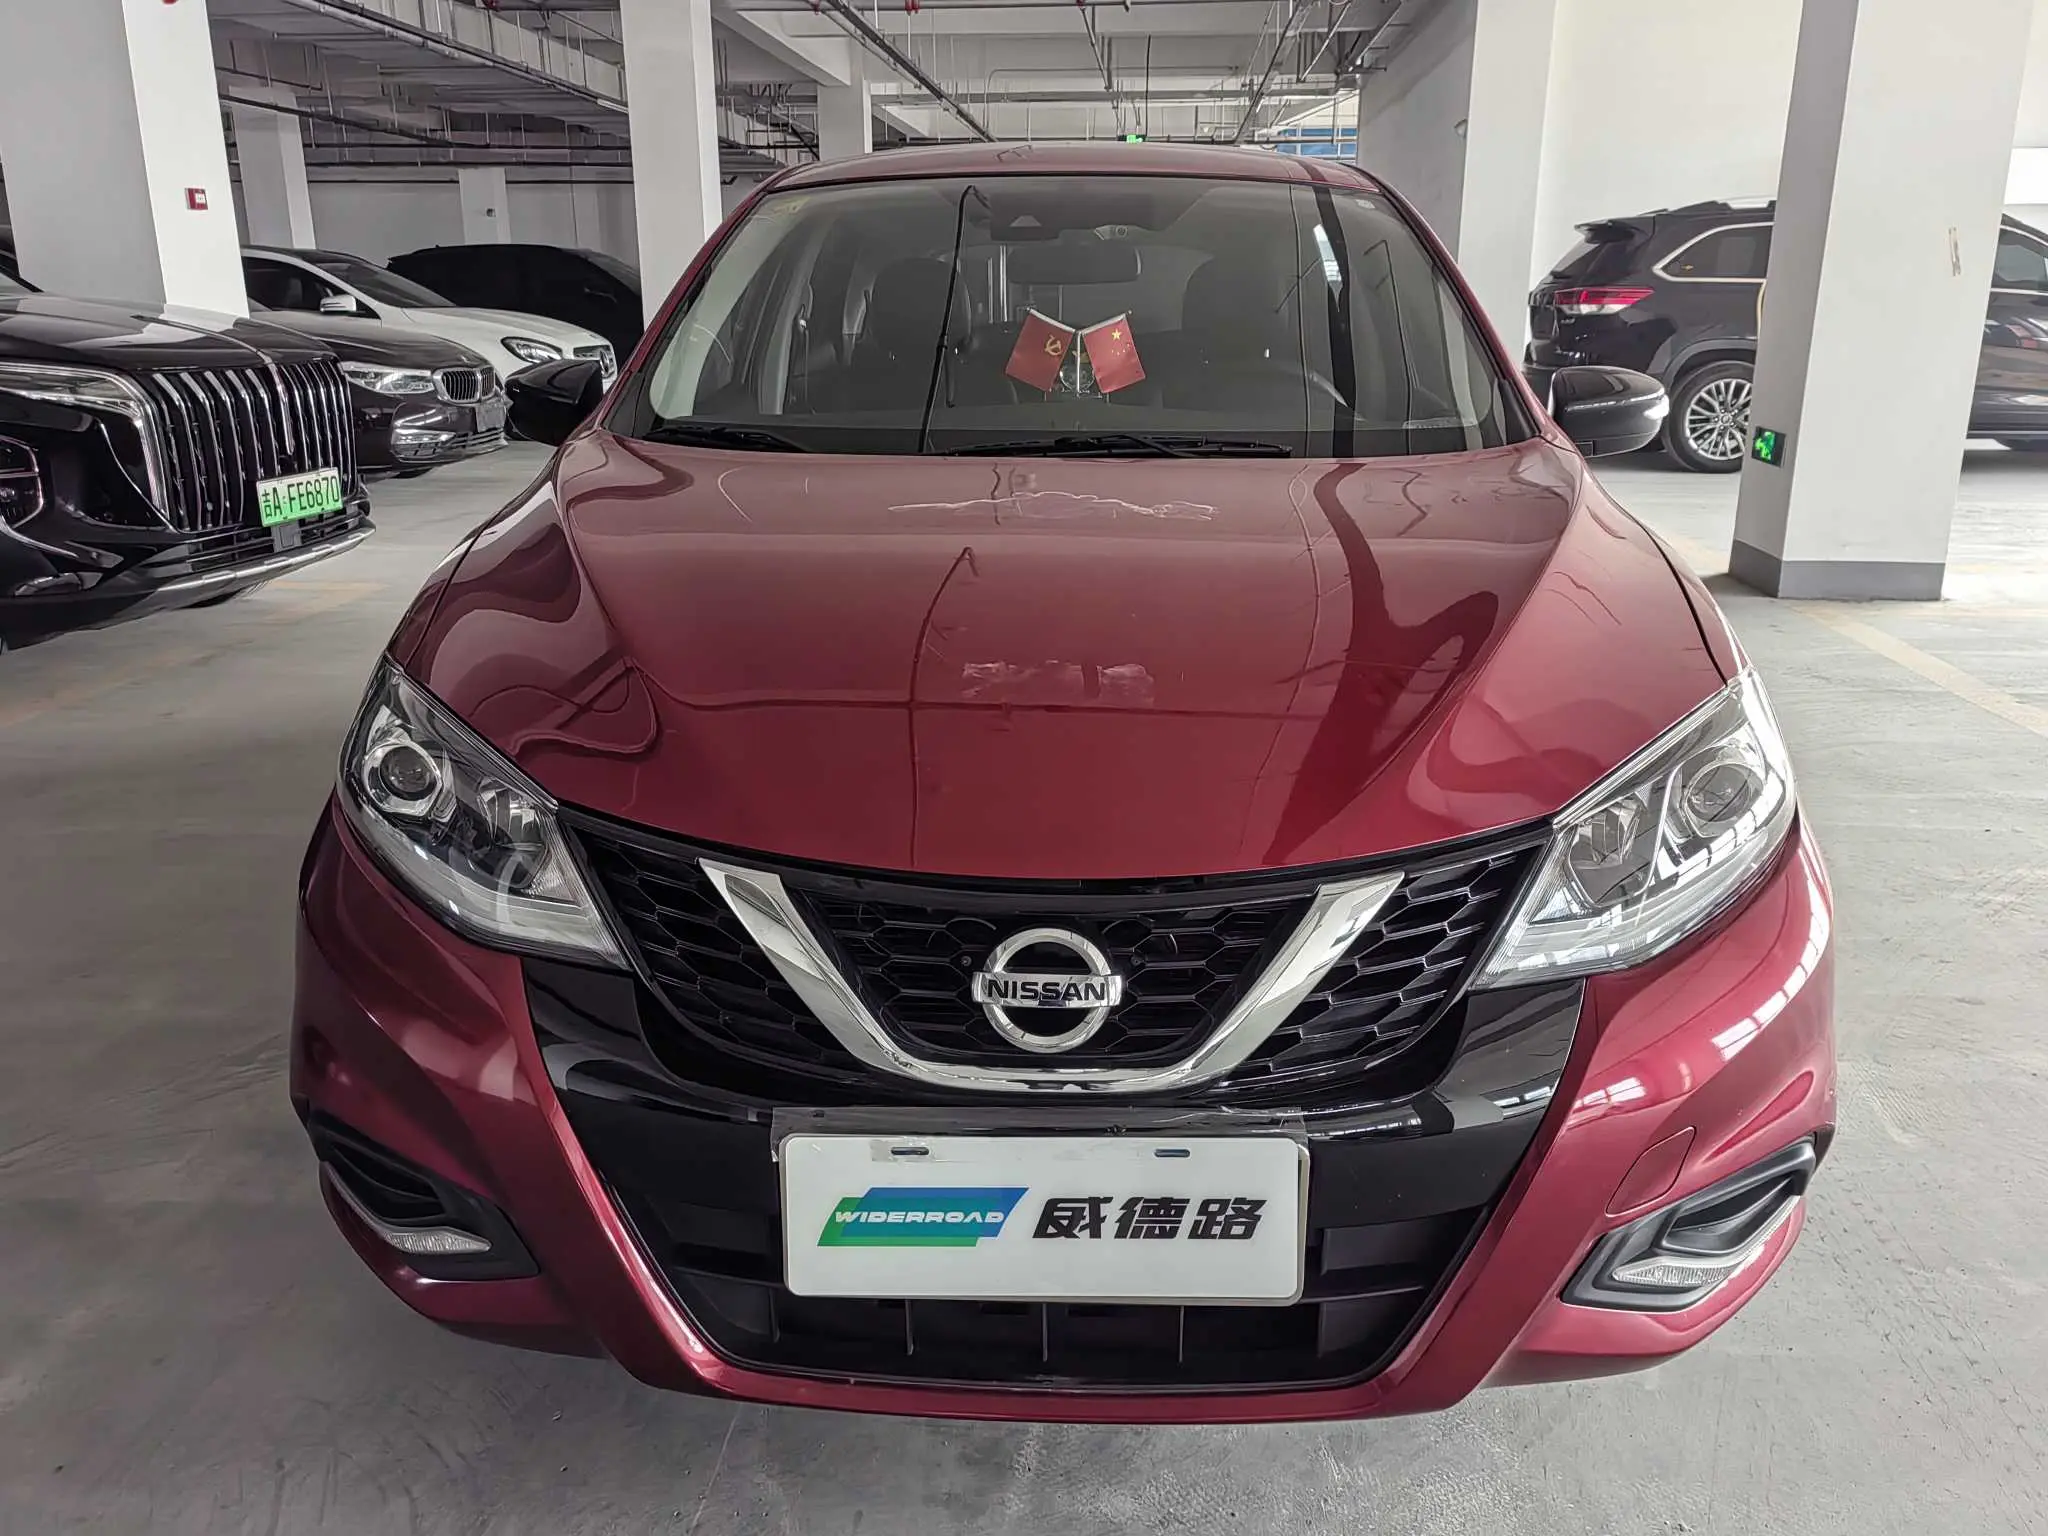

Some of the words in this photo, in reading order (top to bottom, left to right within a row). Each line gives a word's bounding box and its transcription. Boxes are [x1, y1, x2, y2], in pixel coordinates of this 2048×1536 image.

[987, 979, 1106, 1001] NISSAN
[835, 1211, 1005, 1224] WIDERROAD
[1032, 1196, 1268, 1240] 威德路
